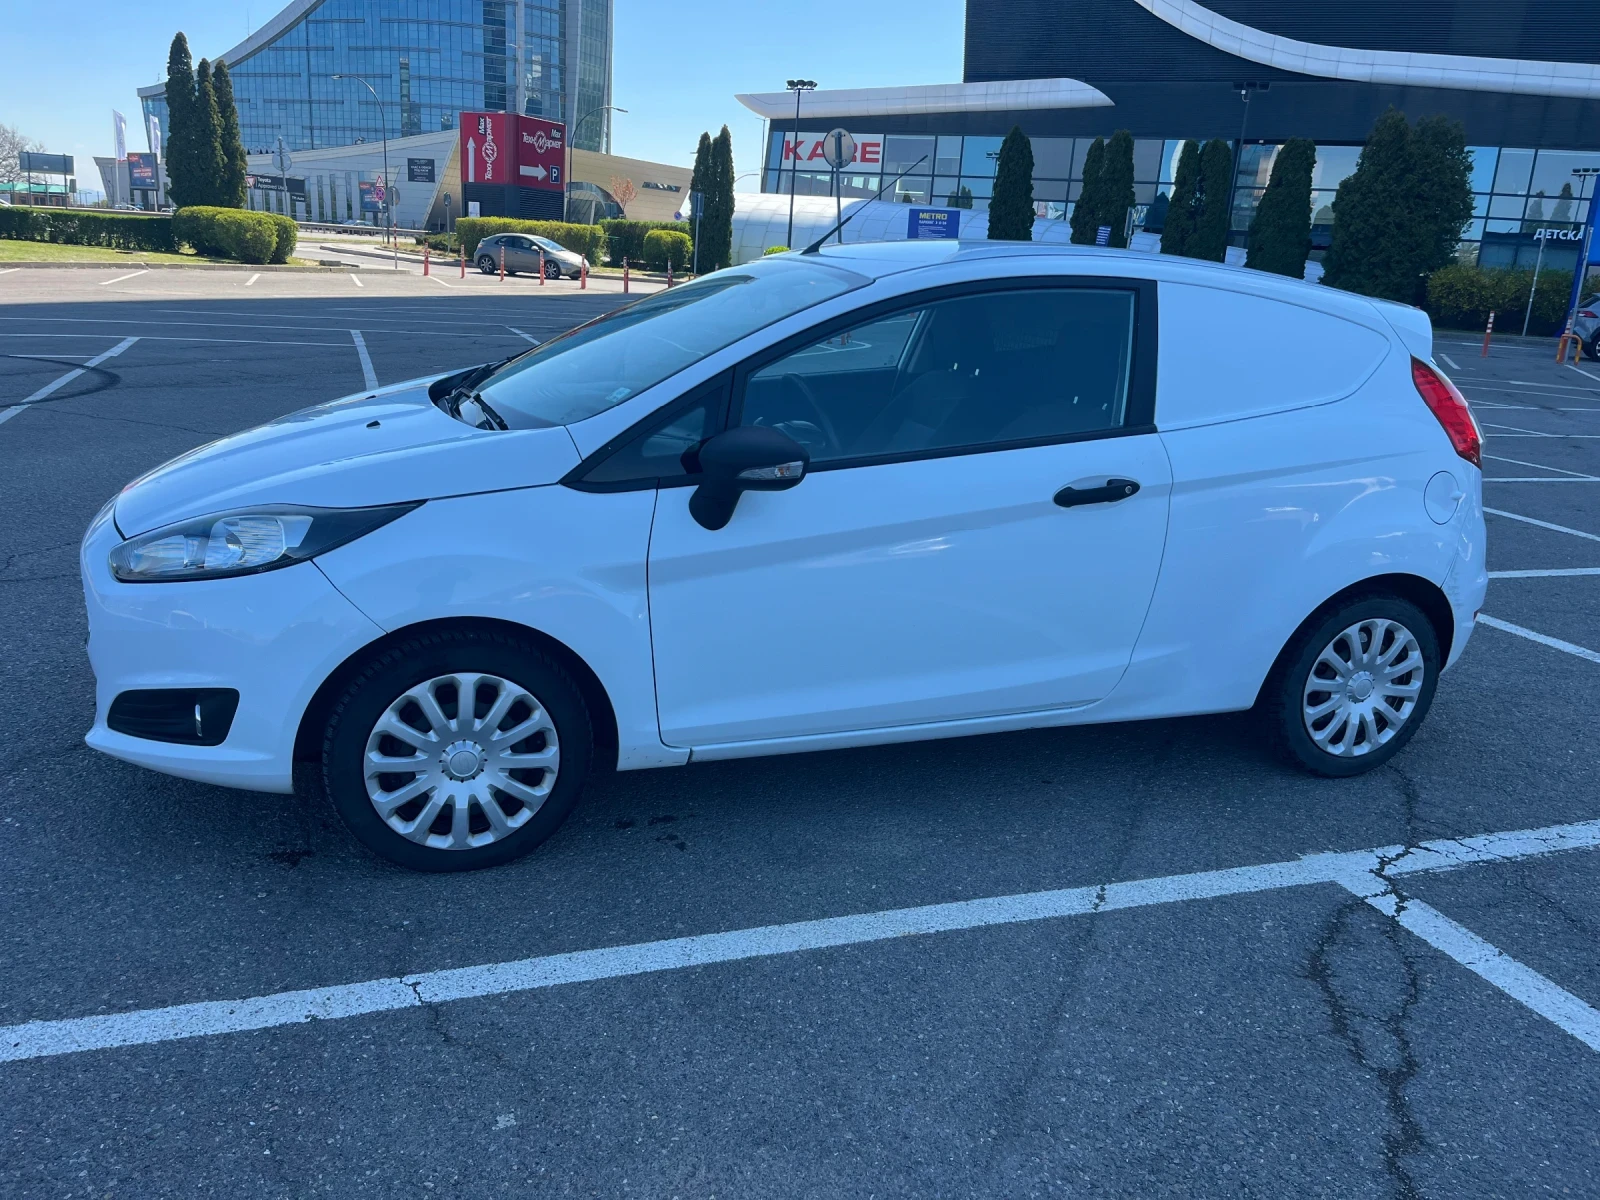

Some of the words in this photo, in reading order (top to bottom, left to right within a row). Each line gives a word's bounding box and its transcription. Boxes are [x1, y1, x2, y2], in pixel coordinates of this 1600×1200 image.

[551, 128, 562, 138] Max
[784, 140, 880, 163] KAE
[919, 212, 948, 220] METRO
